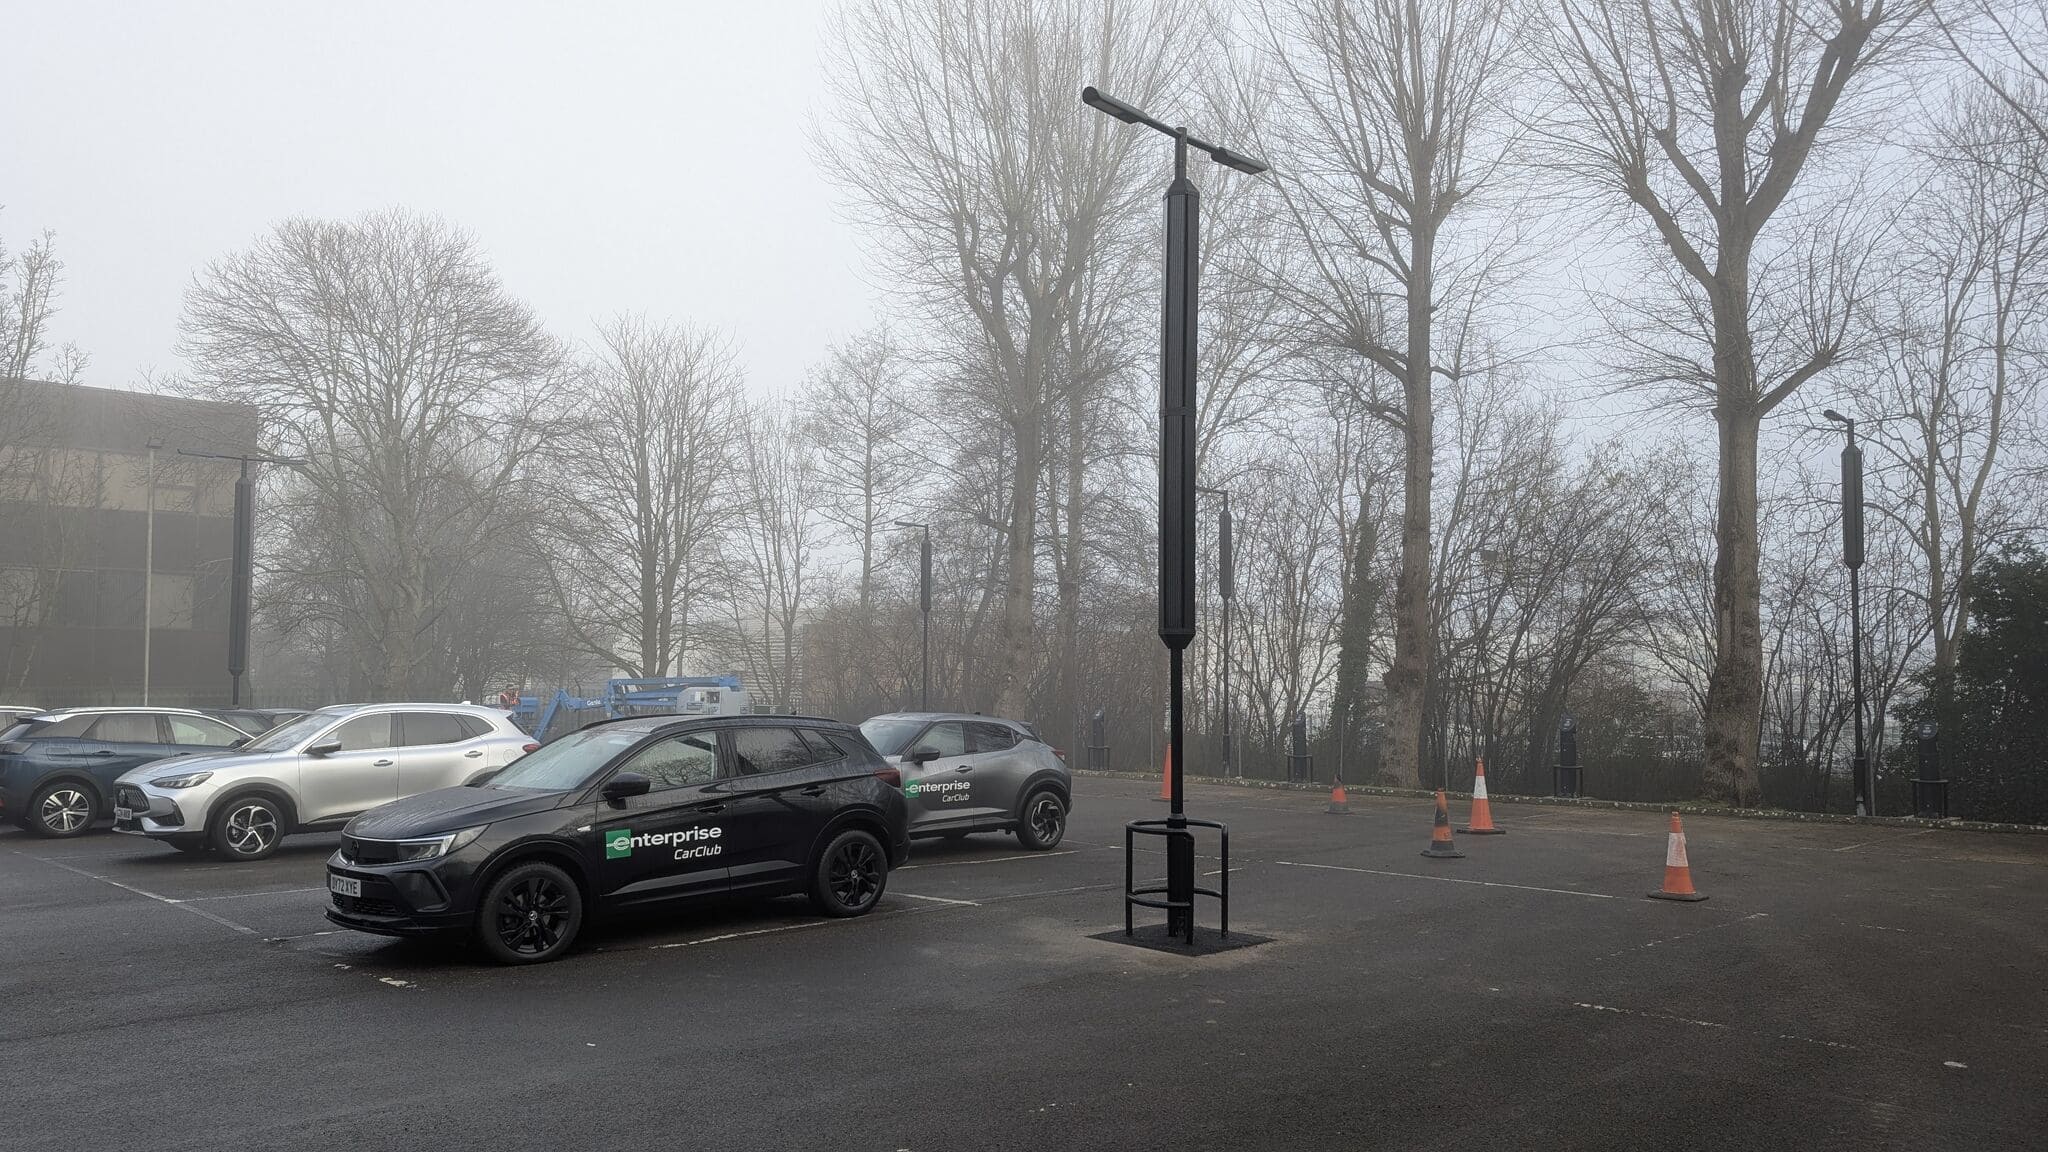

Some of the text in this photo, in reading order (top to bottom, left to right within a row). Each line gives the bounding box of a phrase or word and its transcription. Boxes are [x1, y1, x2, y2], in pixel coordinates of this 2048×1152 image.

[905, 780, 971, 794] enterprise
[942, 793, 970, 803] CarClub
[606, 825, 722, 851] enterprise
[674, 844, 722, 860] CarClub
